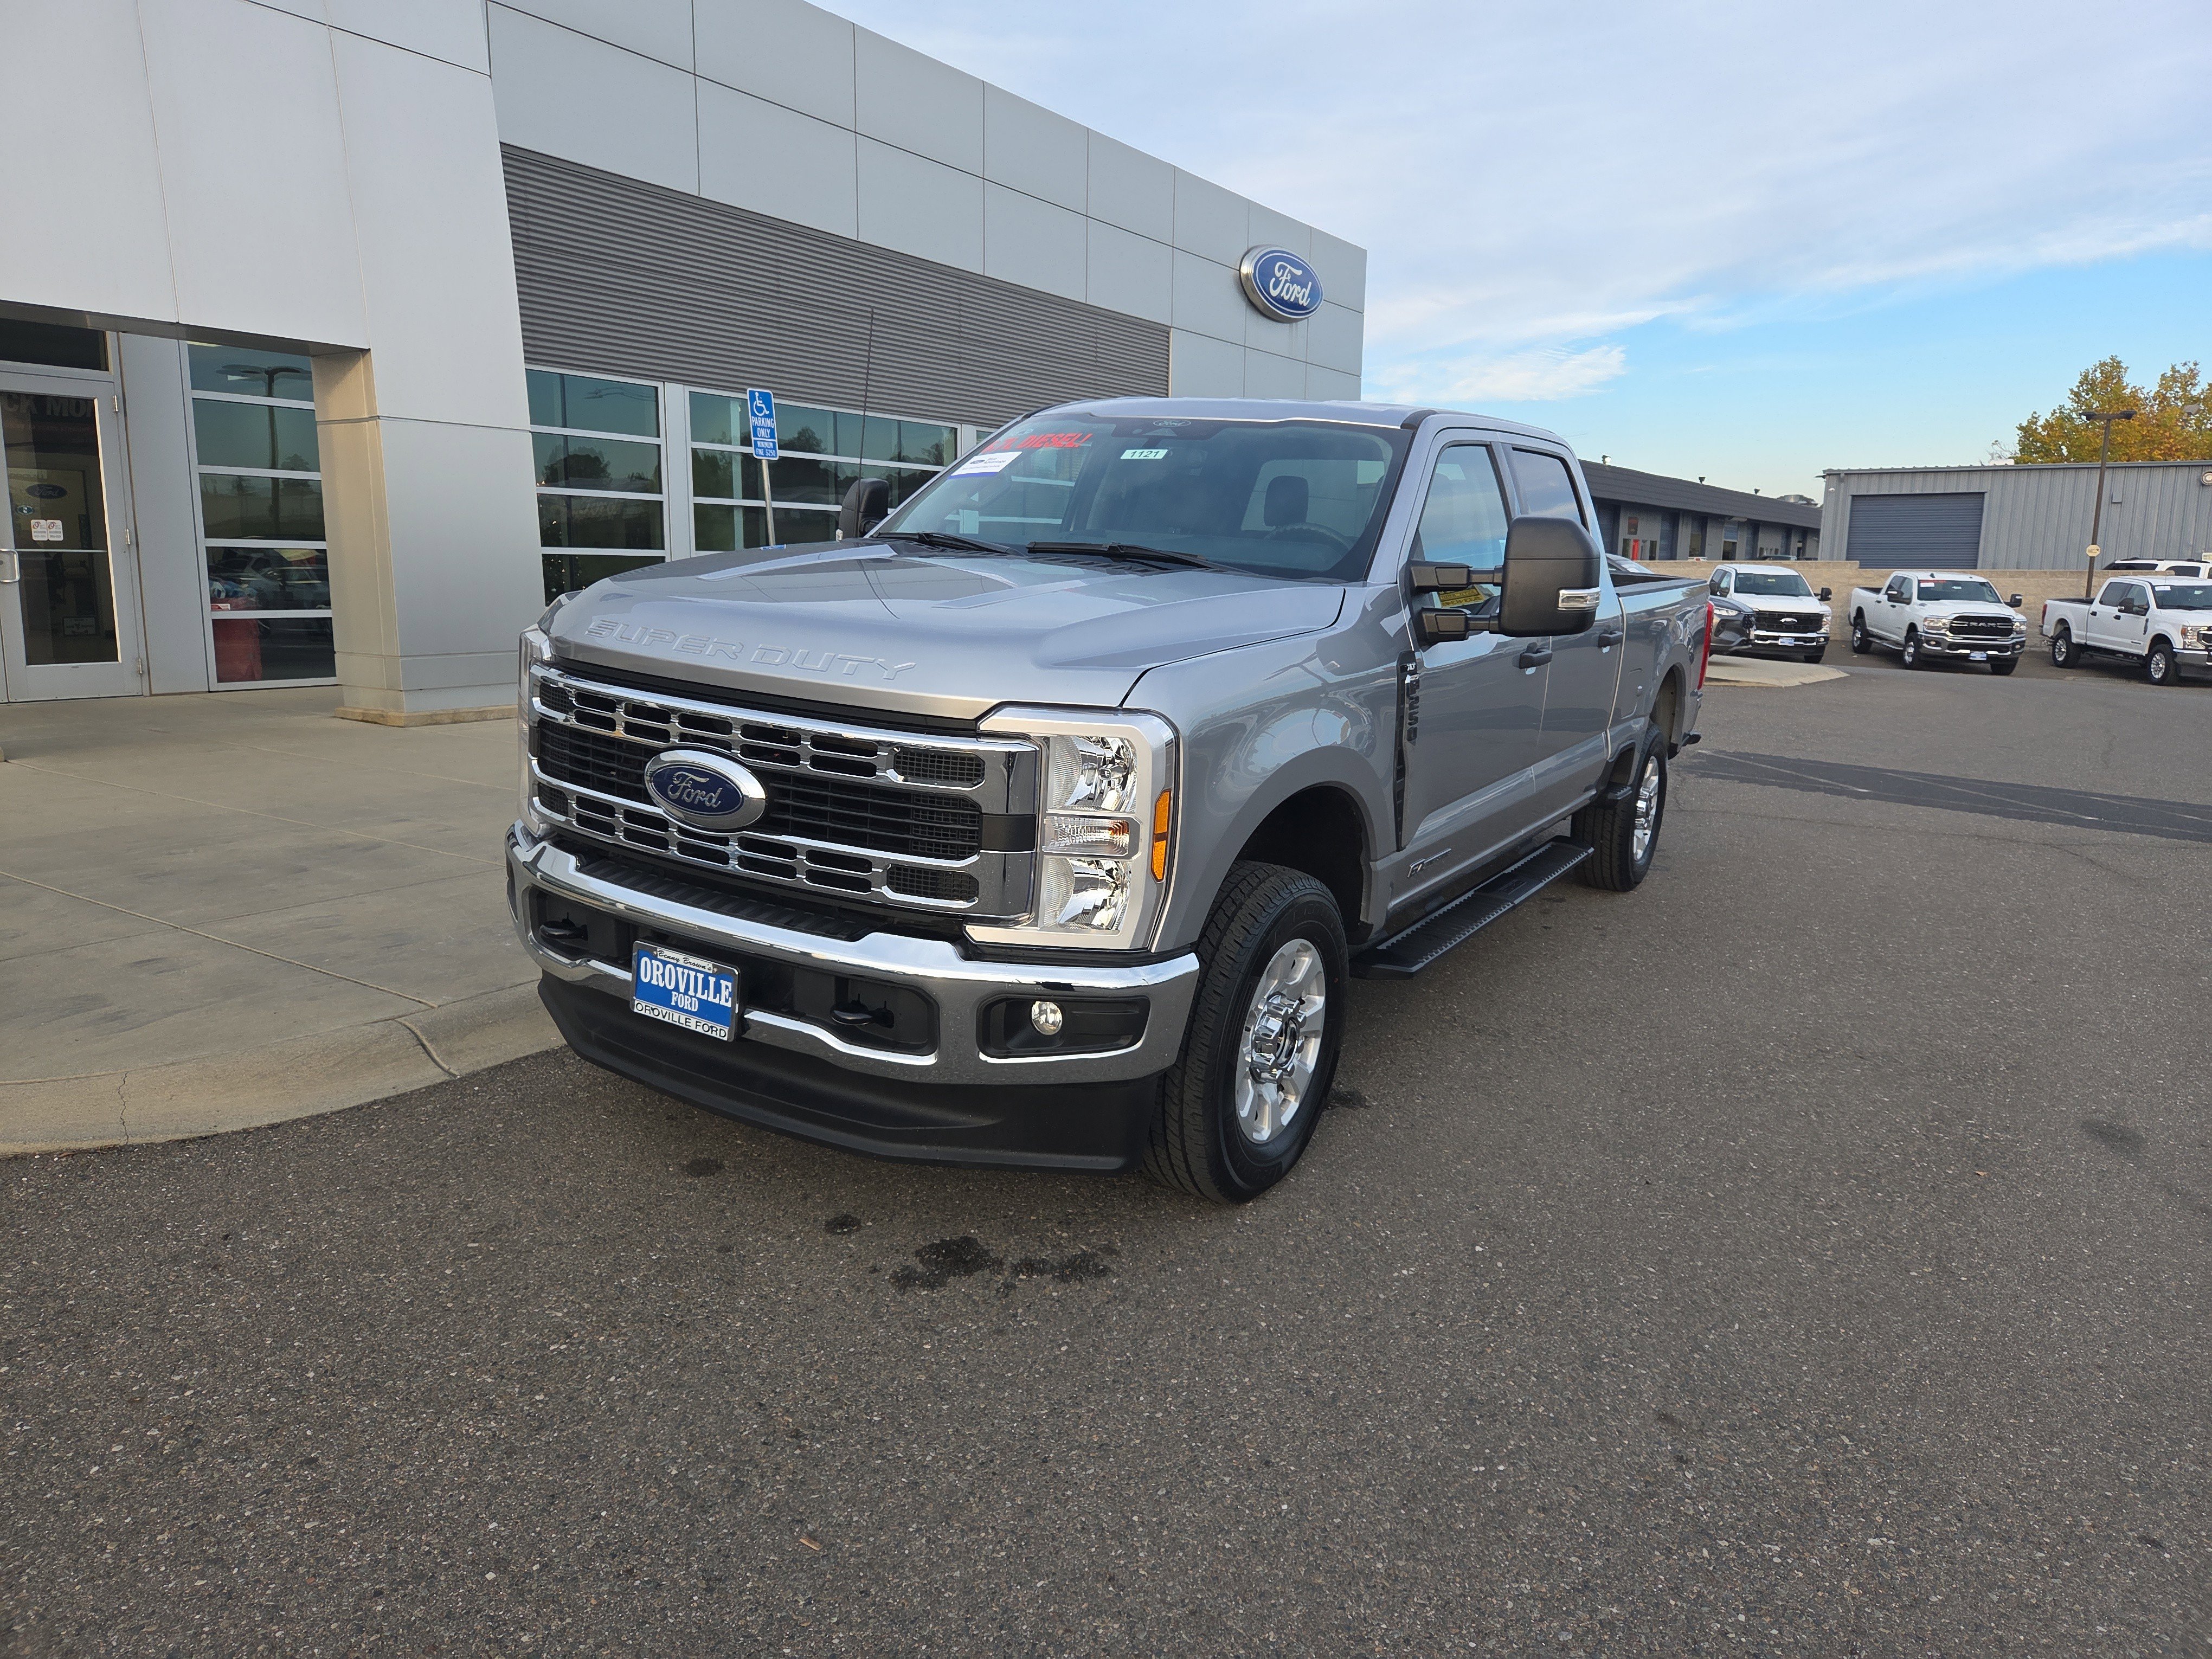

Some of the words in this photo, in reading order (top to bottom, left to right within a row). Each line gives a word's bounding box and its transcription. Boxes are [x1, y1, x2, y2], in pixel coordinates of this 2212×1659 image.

[1269, 261, 1312, 307] Ford
[751, 416, 774, 428] PARKING
[757, 427, 770, 438] ONLY
[1015, 432, 1094, 449] DIESEL!
[1130, 450, 1160, 458] 1121
[584, 619, 744, 660] SUPER
[750, 643, 917, 680] DUTY
[667, 770, 723, 808] Ford
[658, 949, 680, 963] Benny
[683, 956, 712, 971] Brown's
[640, 956, 732, 1008] OROVILLE
[671, 991, 698, 1012] FORD
[635, 1002, 691, 1027] OROVILLE
[695, 1020, 726, 1038] FORD
